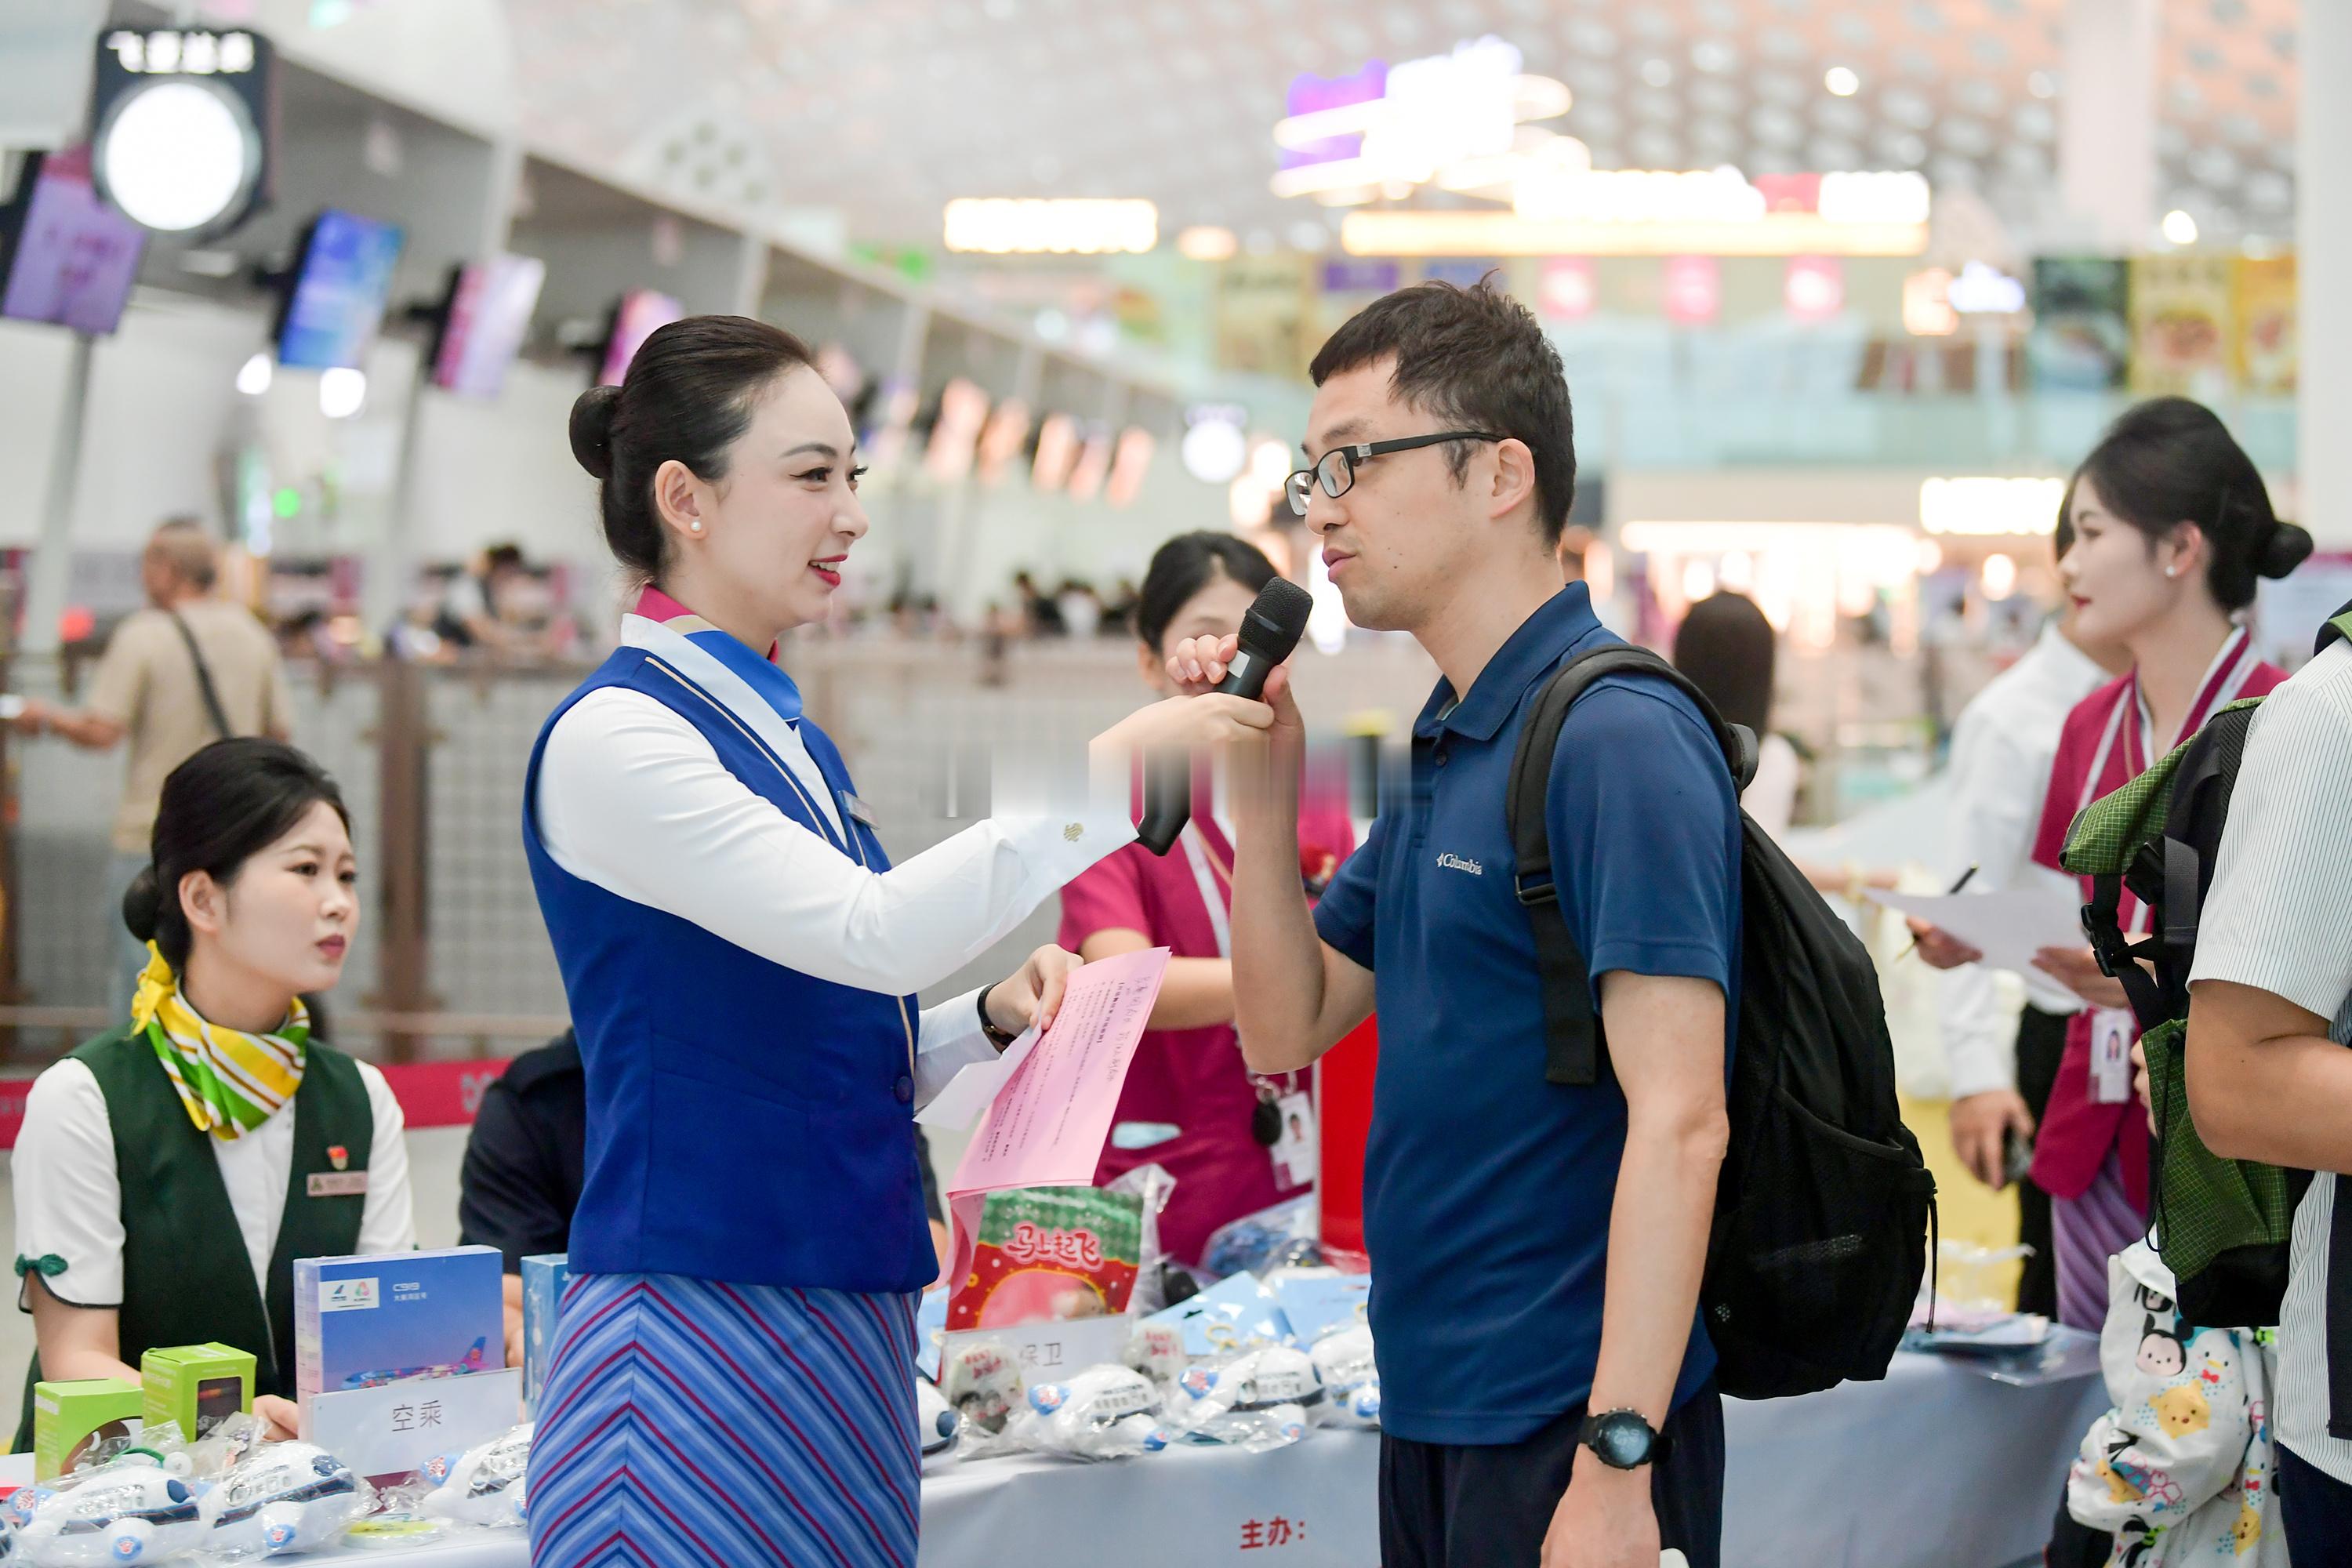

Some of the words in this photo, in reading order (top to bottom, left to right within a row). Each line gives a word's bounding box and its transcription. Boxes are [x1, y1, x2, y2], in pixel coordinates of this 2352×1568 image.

[1443, 854, 1482, 875] Columbia
[1005, 1224, 1102, 1269] 马上起飞
[1018, 1342, 1063, 1368] 保卫
[391, 1399, 442, 1432] 空乘
